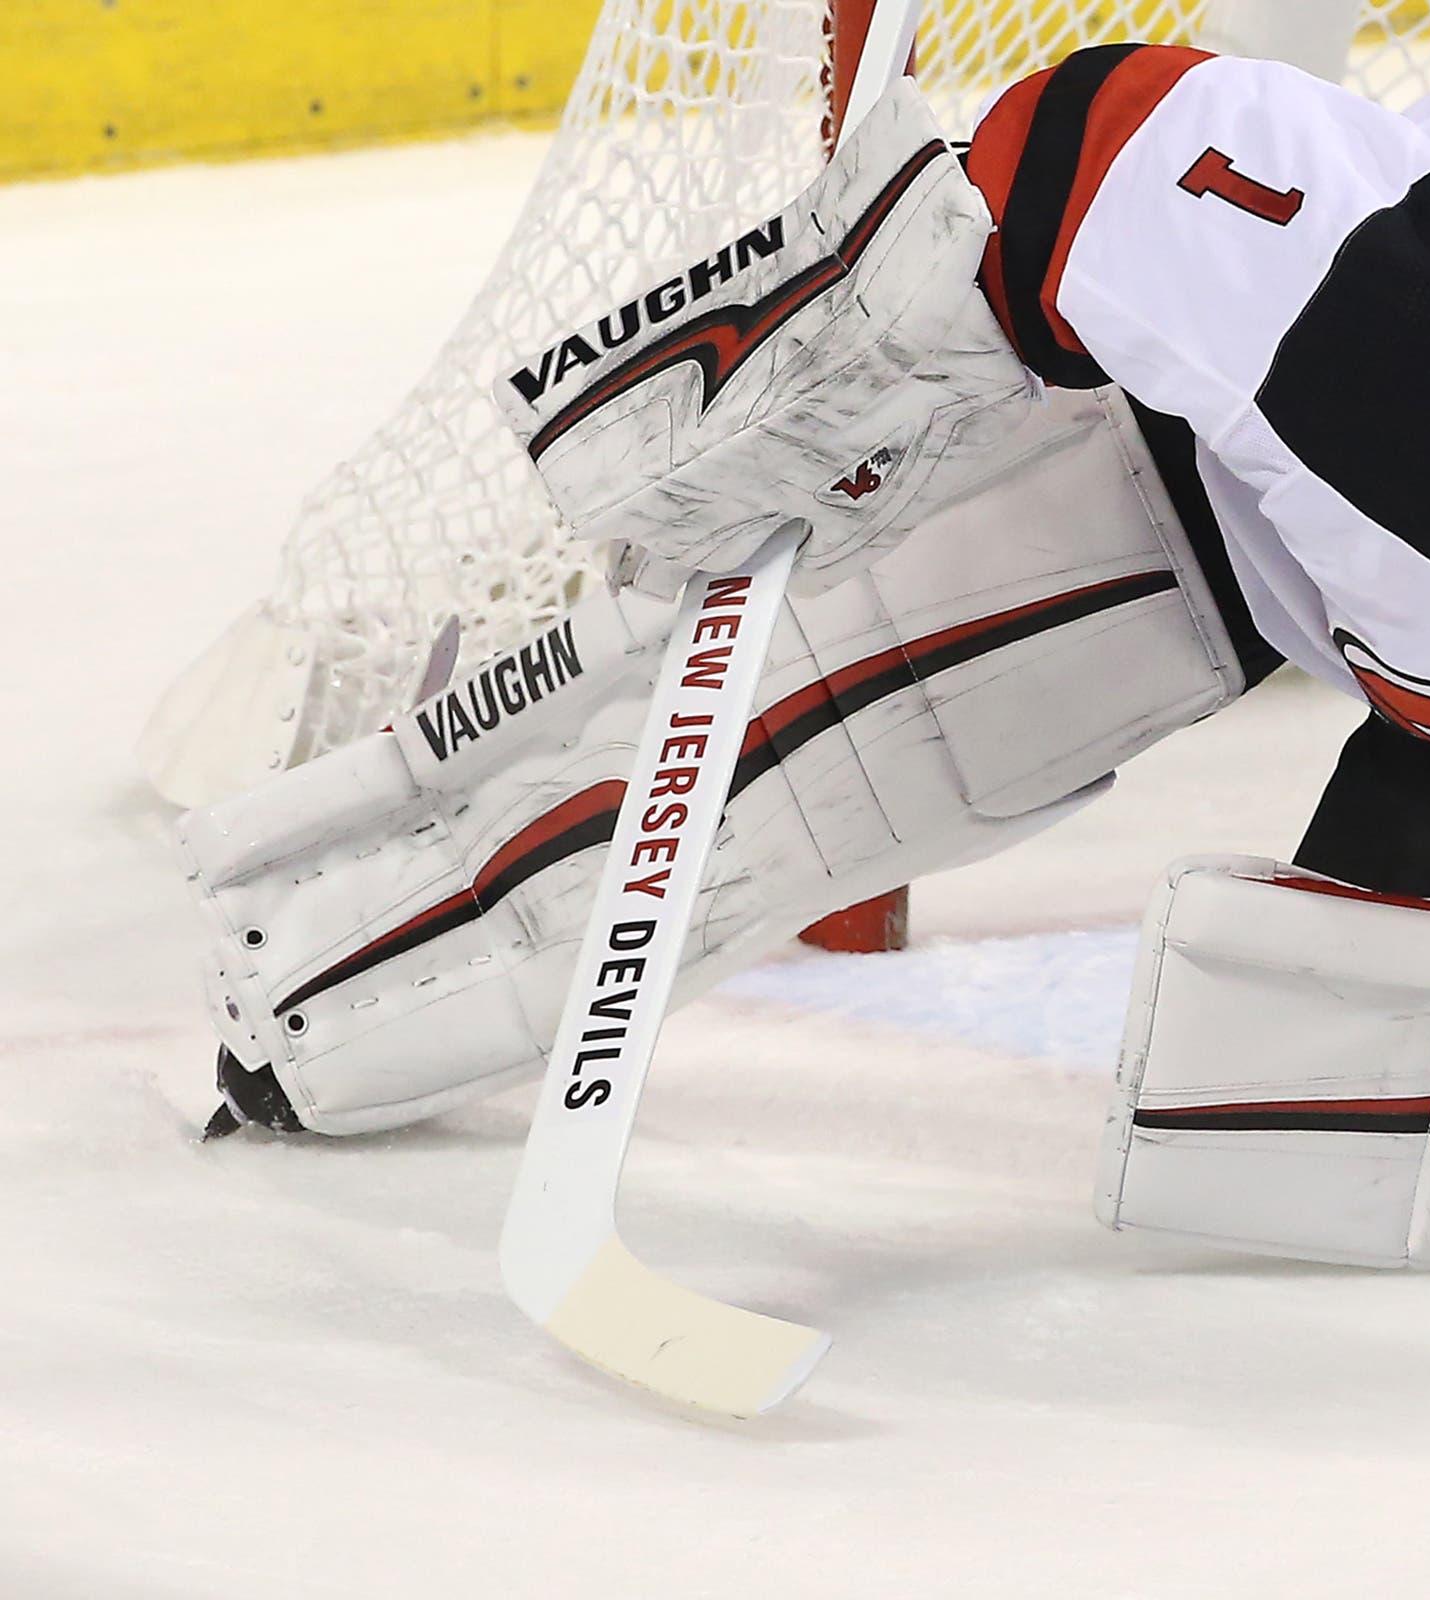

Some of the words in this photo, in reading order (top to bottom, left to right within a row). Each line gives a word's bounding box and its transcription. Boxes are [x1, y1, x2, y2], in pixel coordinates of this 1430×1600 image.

[1176, 145, 1305, 227] 1
[509, 215, 785, 404] VAUGHN
[416, 618, 584, 762] VAUGHN
[680, 575, 753, 691] NEW
[622, 712, 715, 899] JERSEY
[564, 919, 658, 1110] DEVILS
